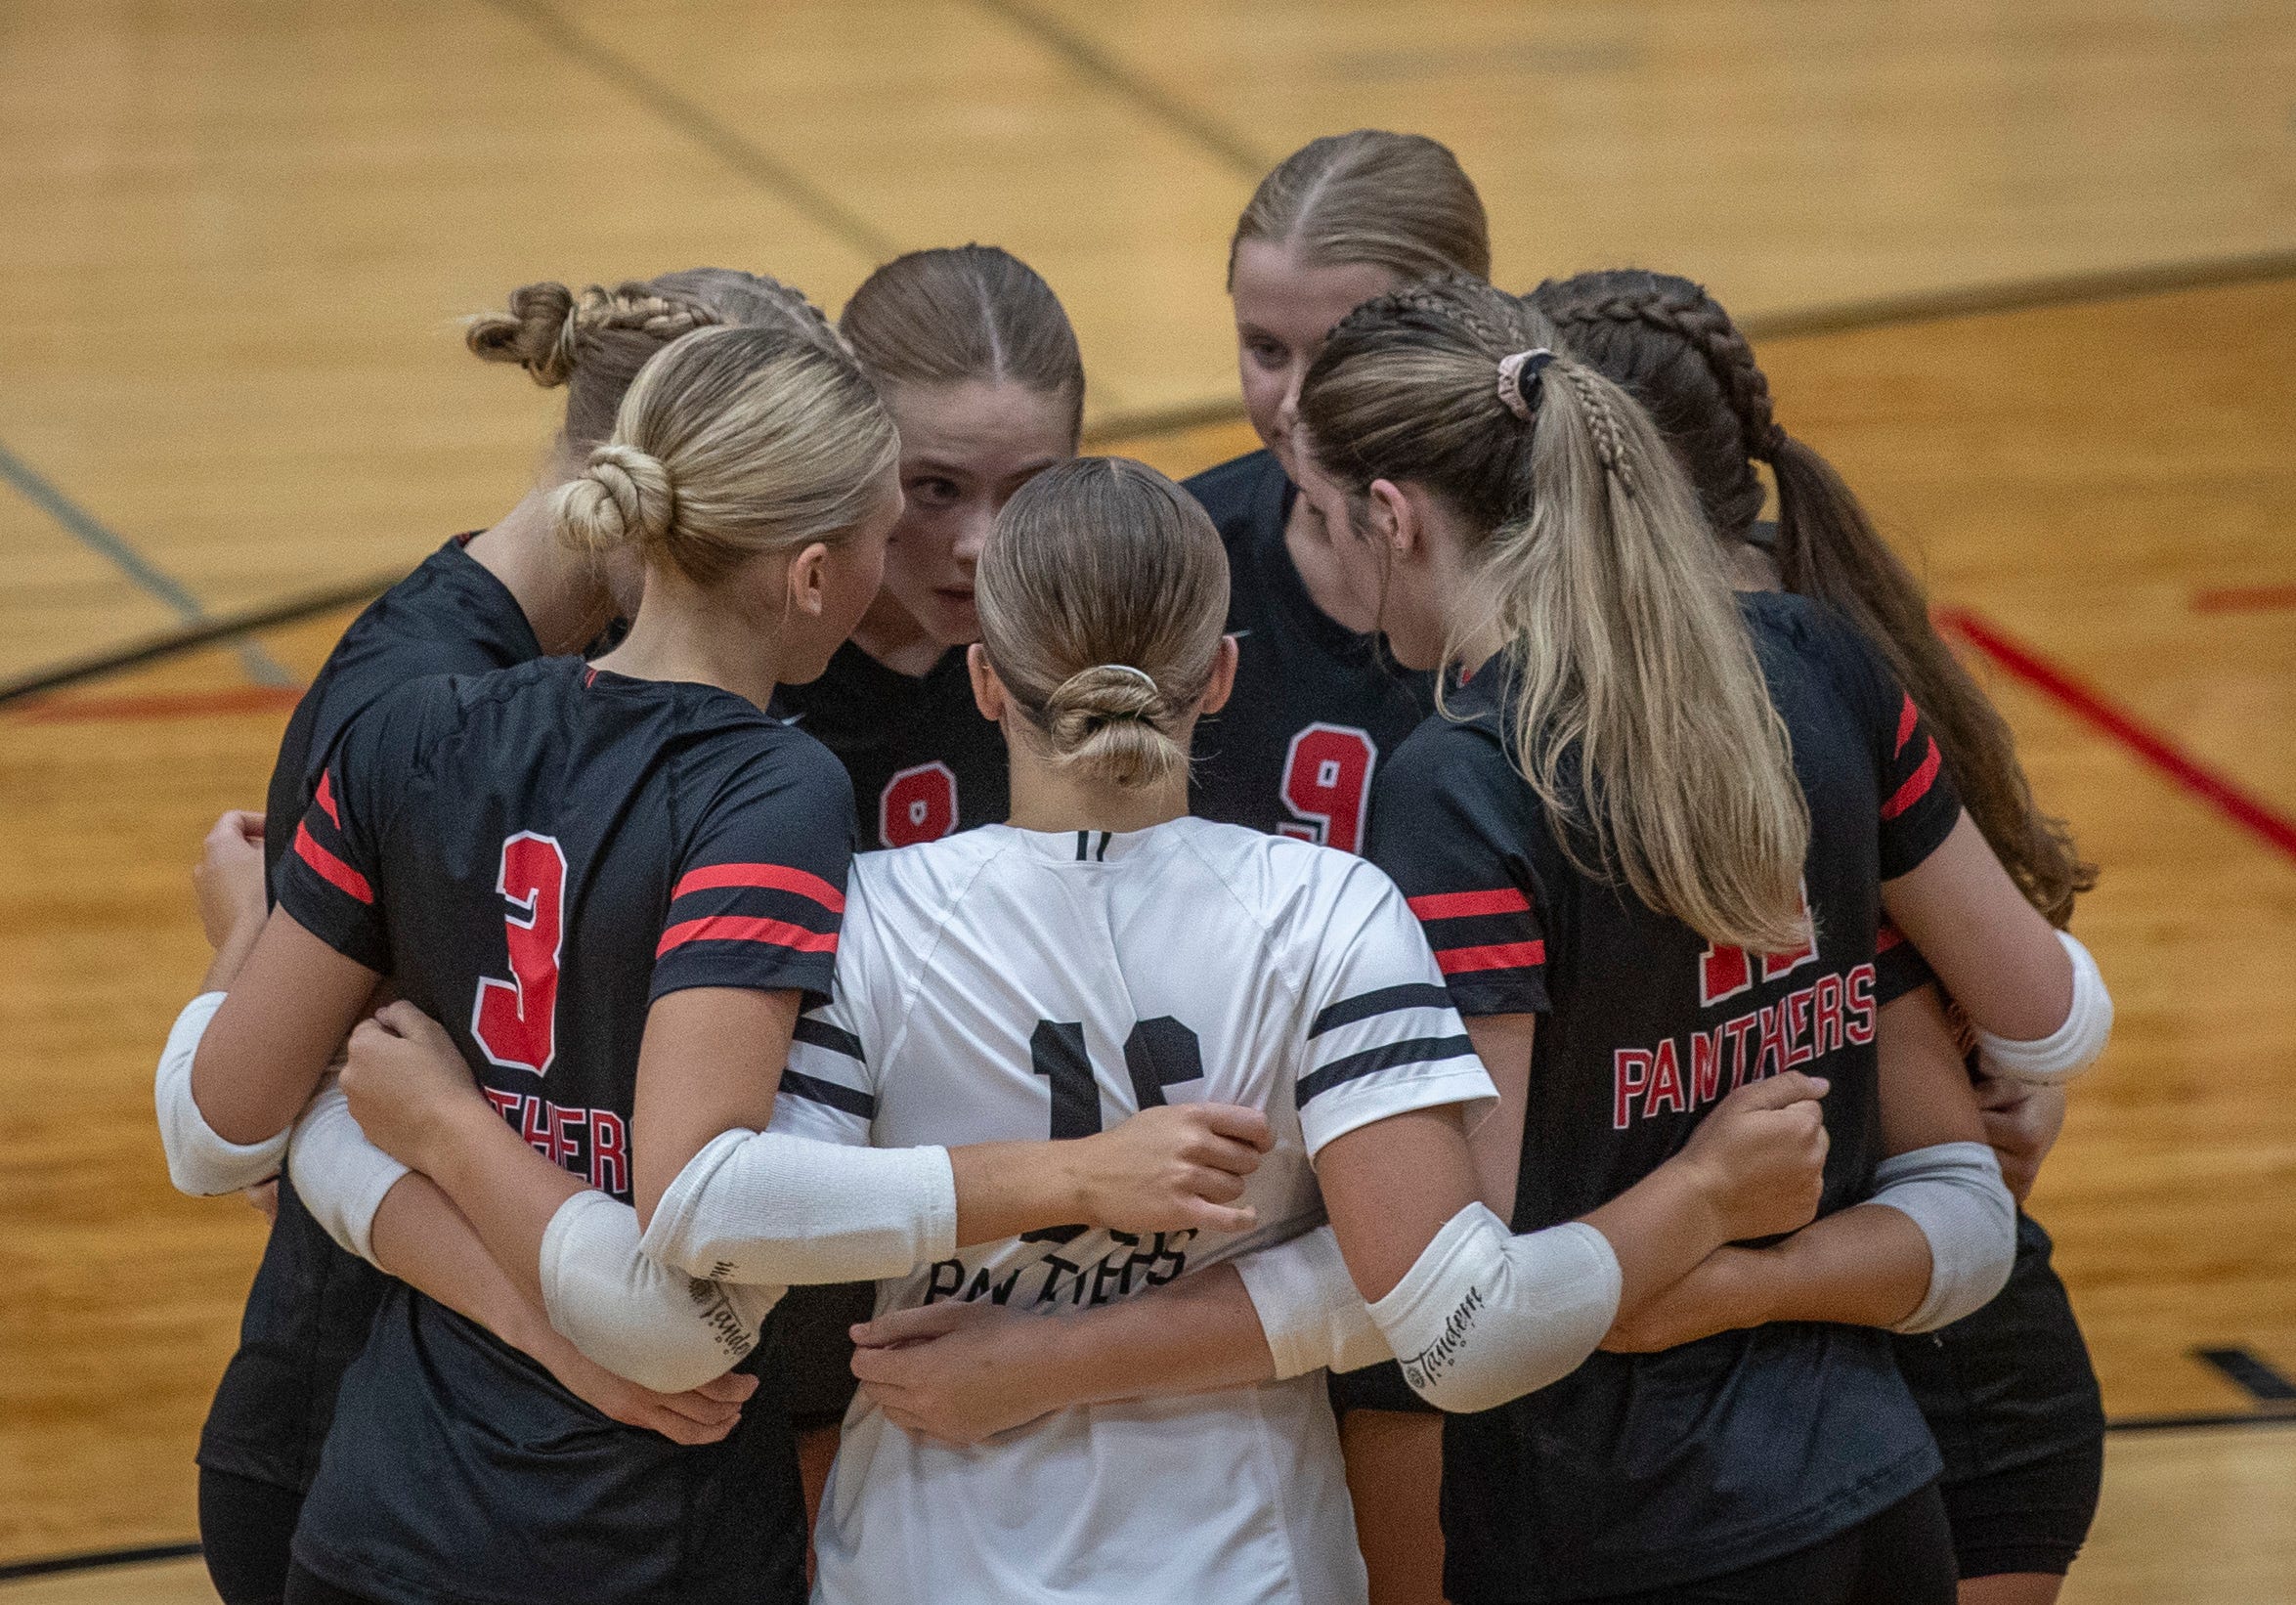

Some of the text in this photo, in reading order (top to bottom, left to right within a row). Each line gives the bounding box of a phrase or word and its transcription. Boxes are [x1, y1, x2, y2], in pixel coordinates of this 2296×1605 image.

[1275, 721, 1379, 856] 9
[470, 830, 568, 1077] 3
[1614, 962, 1878, 1130] PANTHERS
[1399, 1285, 1485, 1386] Tandem
